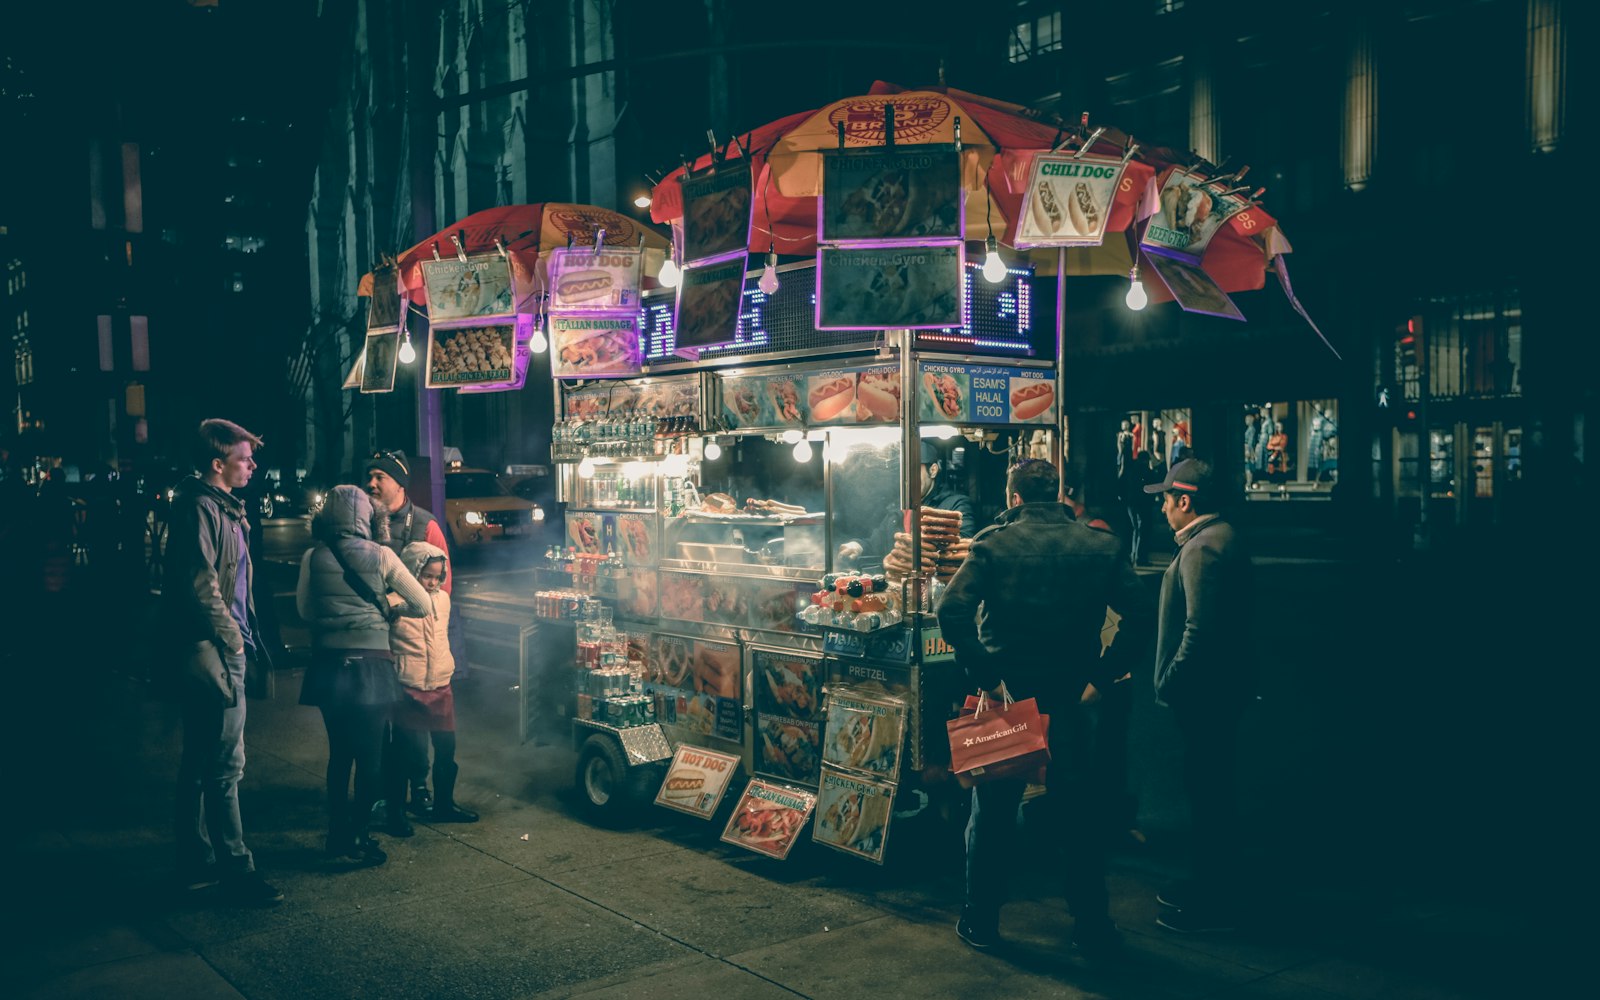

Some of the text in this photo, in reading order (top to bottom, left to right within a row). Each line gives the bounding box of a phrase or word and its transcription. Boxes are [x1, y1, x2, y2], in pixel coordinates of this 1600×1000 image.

[850, 100, 941, 112] GODEN
[1041, 163, 1115, 179] CHILI DOG
[1147, 225, 1190, 248] BEEF GYRO
[563, 256, 633, 267] HOT DOG
[829, 253, 889, 267] Chicken
[892, 253, 927, 267] Gyro
[427, 261, 489, 275] Chicken Gyro
[555, 320, 632, 330] ITALIAN SAUSAGE
[432, 369, 510, 382] HALAL CHICKEN KEBAB
[832, 370, 844, 378] DOG
[867, 366, 897, 375] CHILI DOG
[923, 364, 966, 374] CHICKEN GYRO
[1020, 371, 1032, 379] HOT
[767, 375, 789, 383] CHICKEN
[973, 377, 1006, 390] ESAM'S
[975, 391, 1004, 403] HALAL
[976, 405, 1003, 417] FOOD
[660, 635, 682, 645] PRETZEL
[827, 631, 866, 648] Halal
[848, 665, 888, 681] PRETZEL
[833, 697, 866, 710] HICKEN
[775, 715, 795, 725] KEBAB
[795, 719, 804, 727] ON
[805, 721, 819, 729] PITA
[974, 722, 1028, 744] American Girl
[680, 752, 728, 773] HOT DOG
[824, 774, 856, 790] CHICKEN
[775, 794, 808, 812] SAUSAGE
